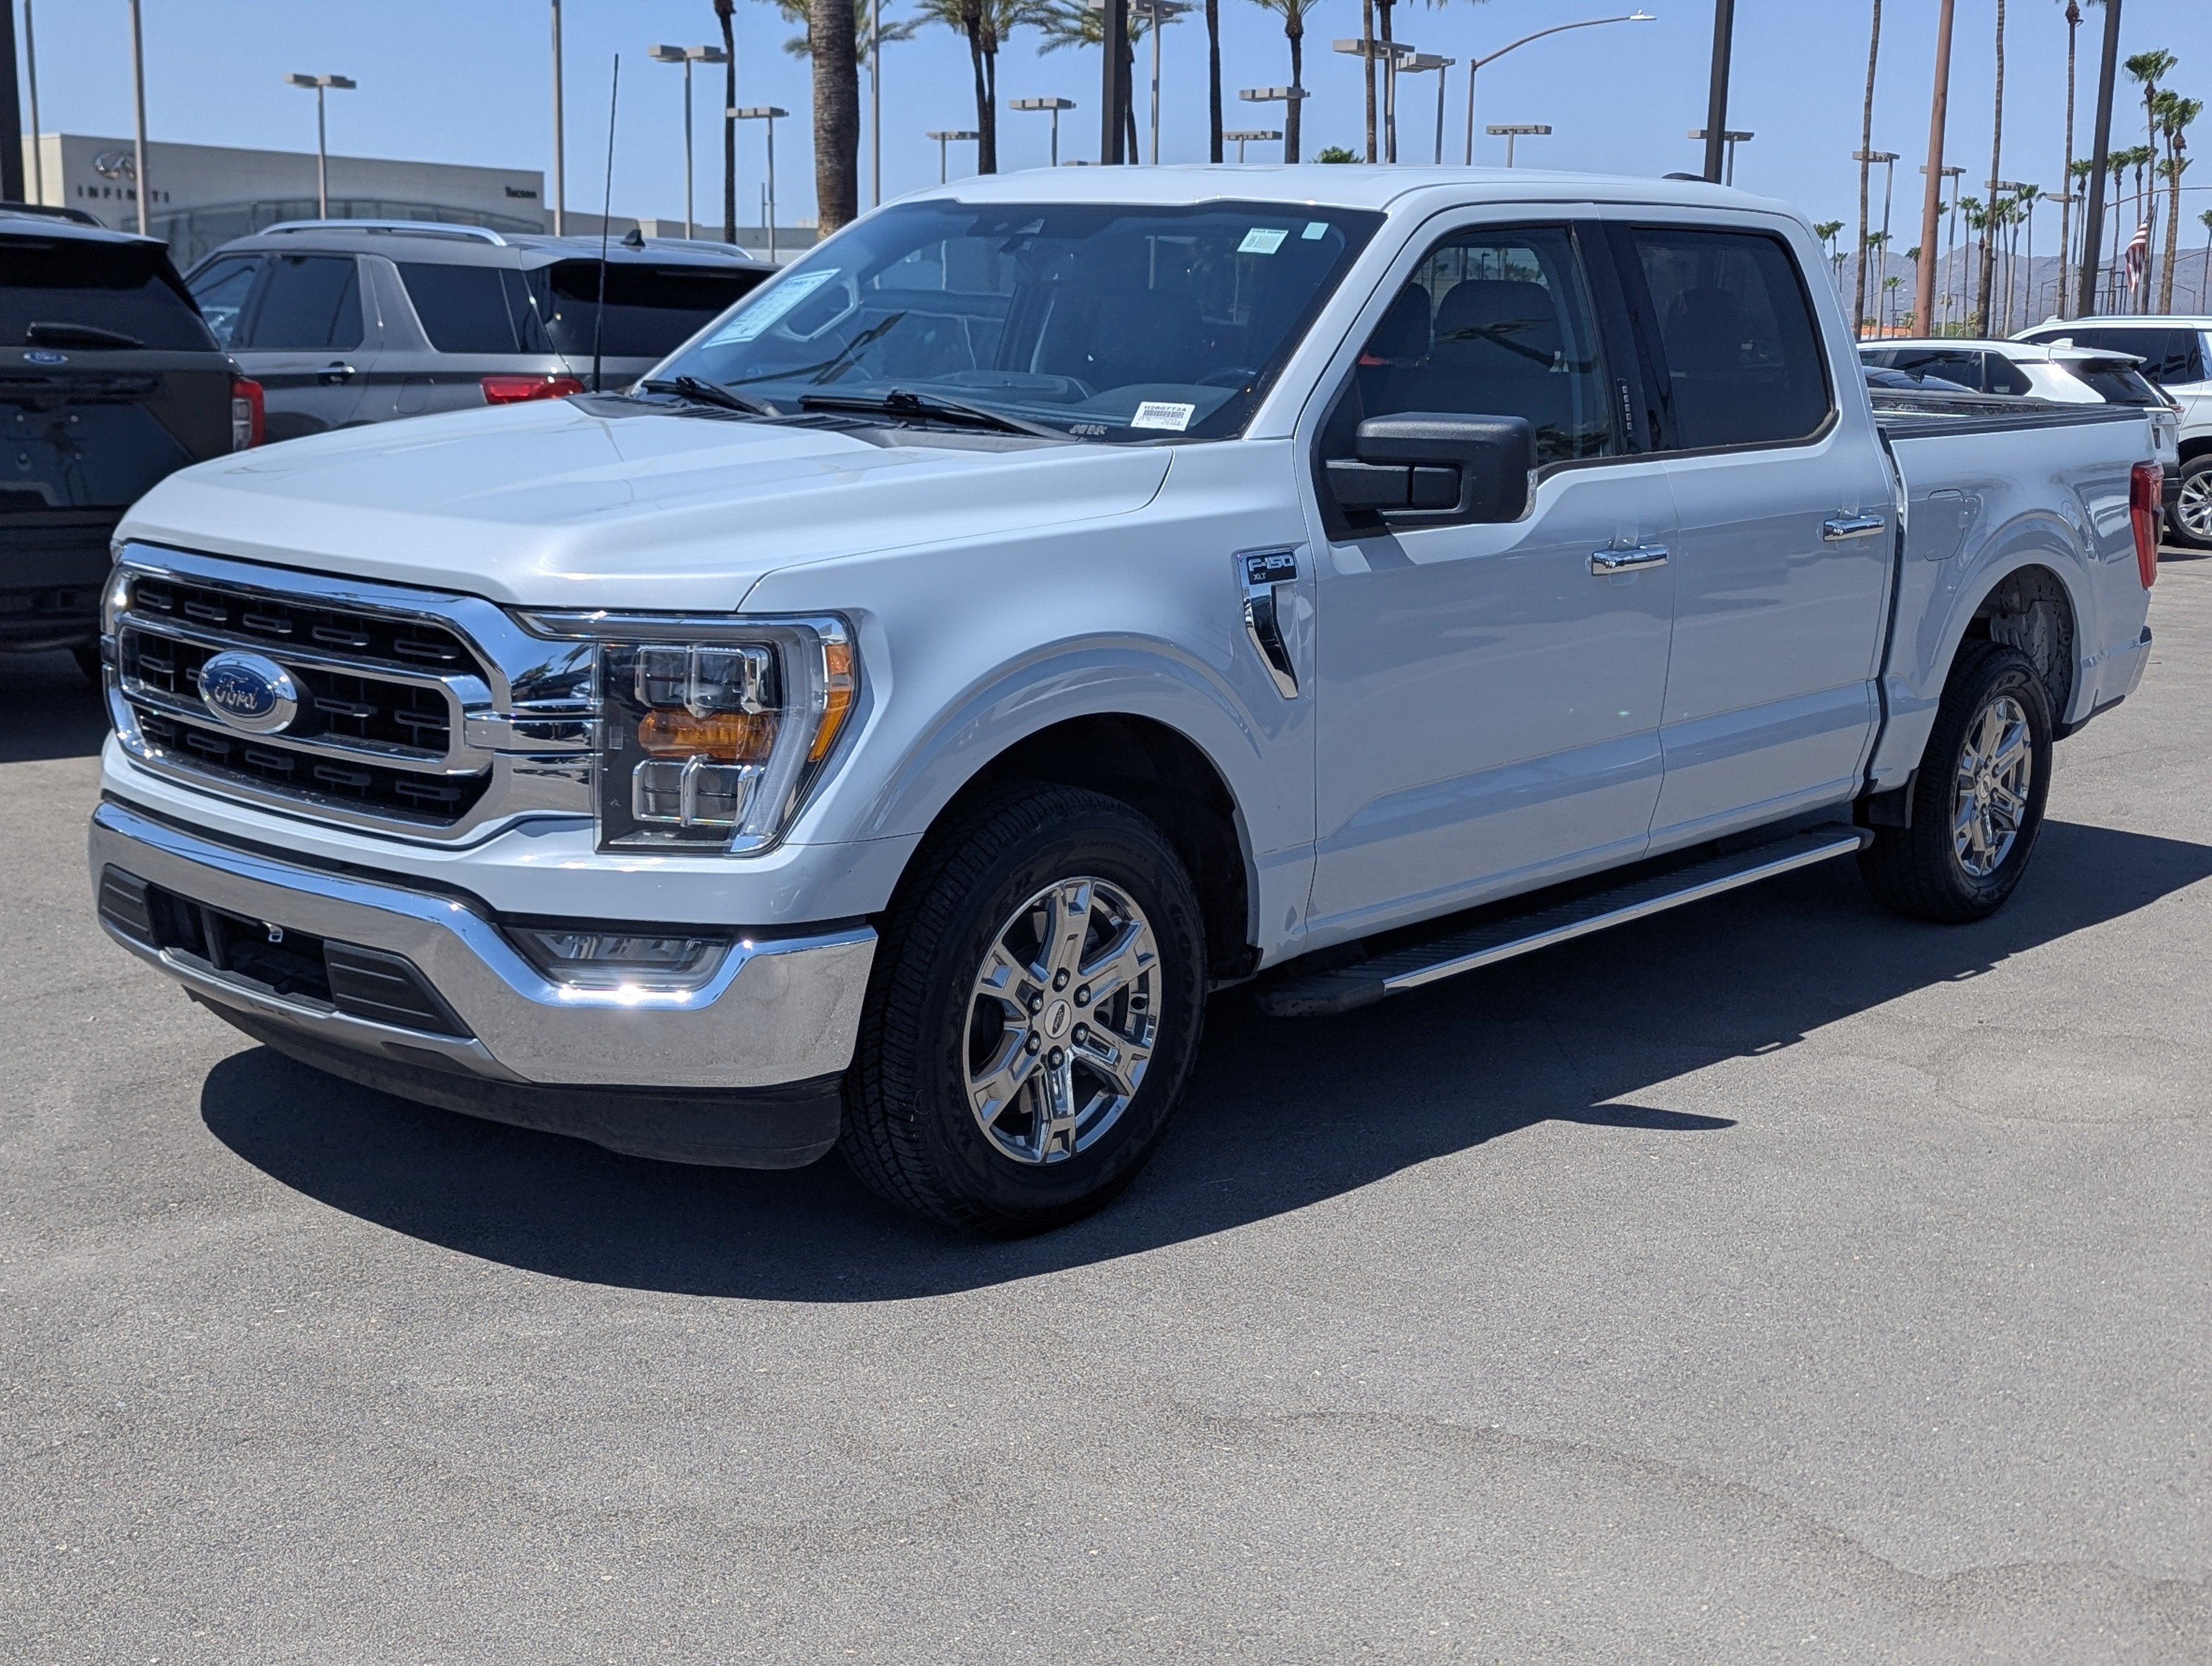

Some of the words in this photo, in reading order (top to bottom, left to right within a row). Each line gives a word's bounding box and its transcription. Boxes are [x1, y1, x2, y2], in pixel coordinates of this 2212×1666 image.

[78, 184, 169, 203] INFINTI
[1248, 554, 1294, 572] F-150
[1253, 572, 1266, 581] XLT
[215, 671, 259, 709] Ford
